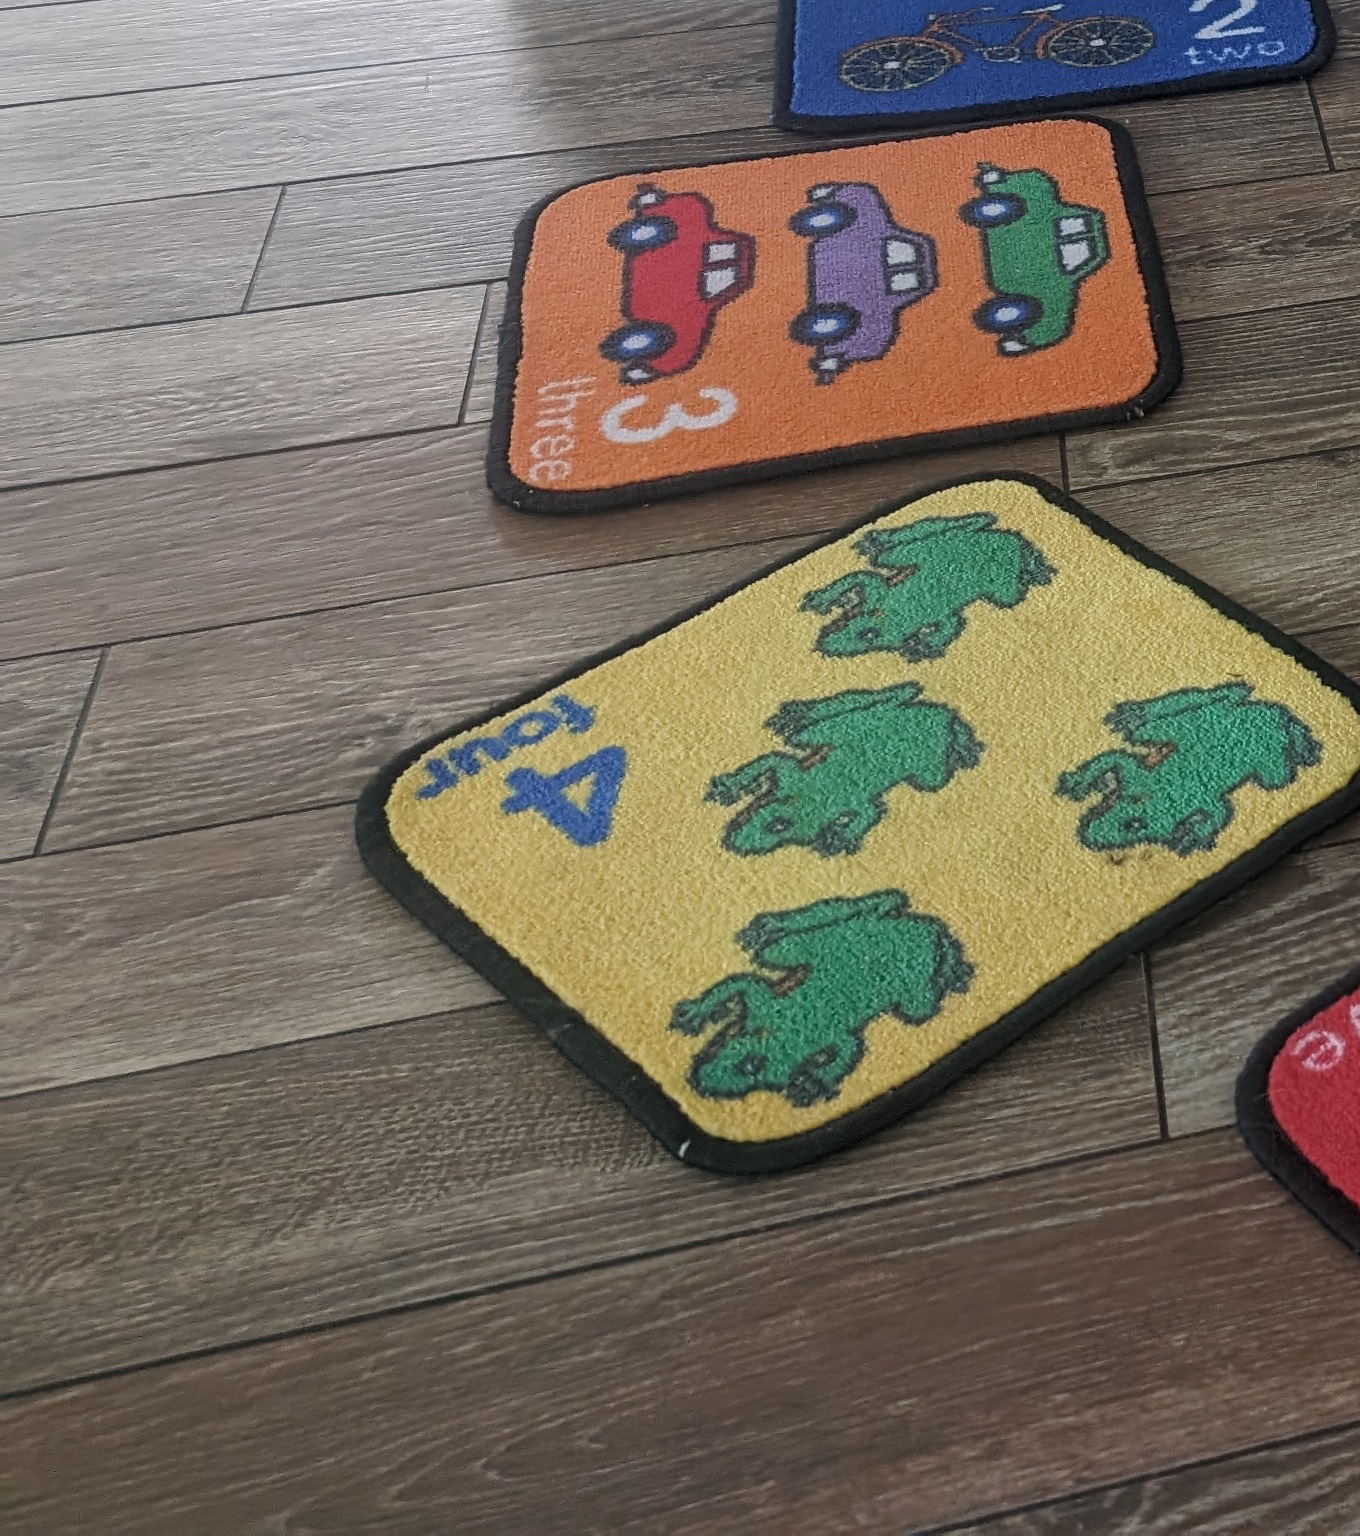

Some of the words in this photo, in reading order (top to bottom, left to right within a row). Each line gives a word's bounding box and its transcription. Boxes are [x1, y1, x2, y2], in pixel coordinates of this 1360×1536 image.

[1184, 39, 1285, 65] two
[528, 376, 597, 482] three
[600, 387, 737, 444] 3
[417, 693, 597, 799] four
[500, 745, 628, 848] 4
